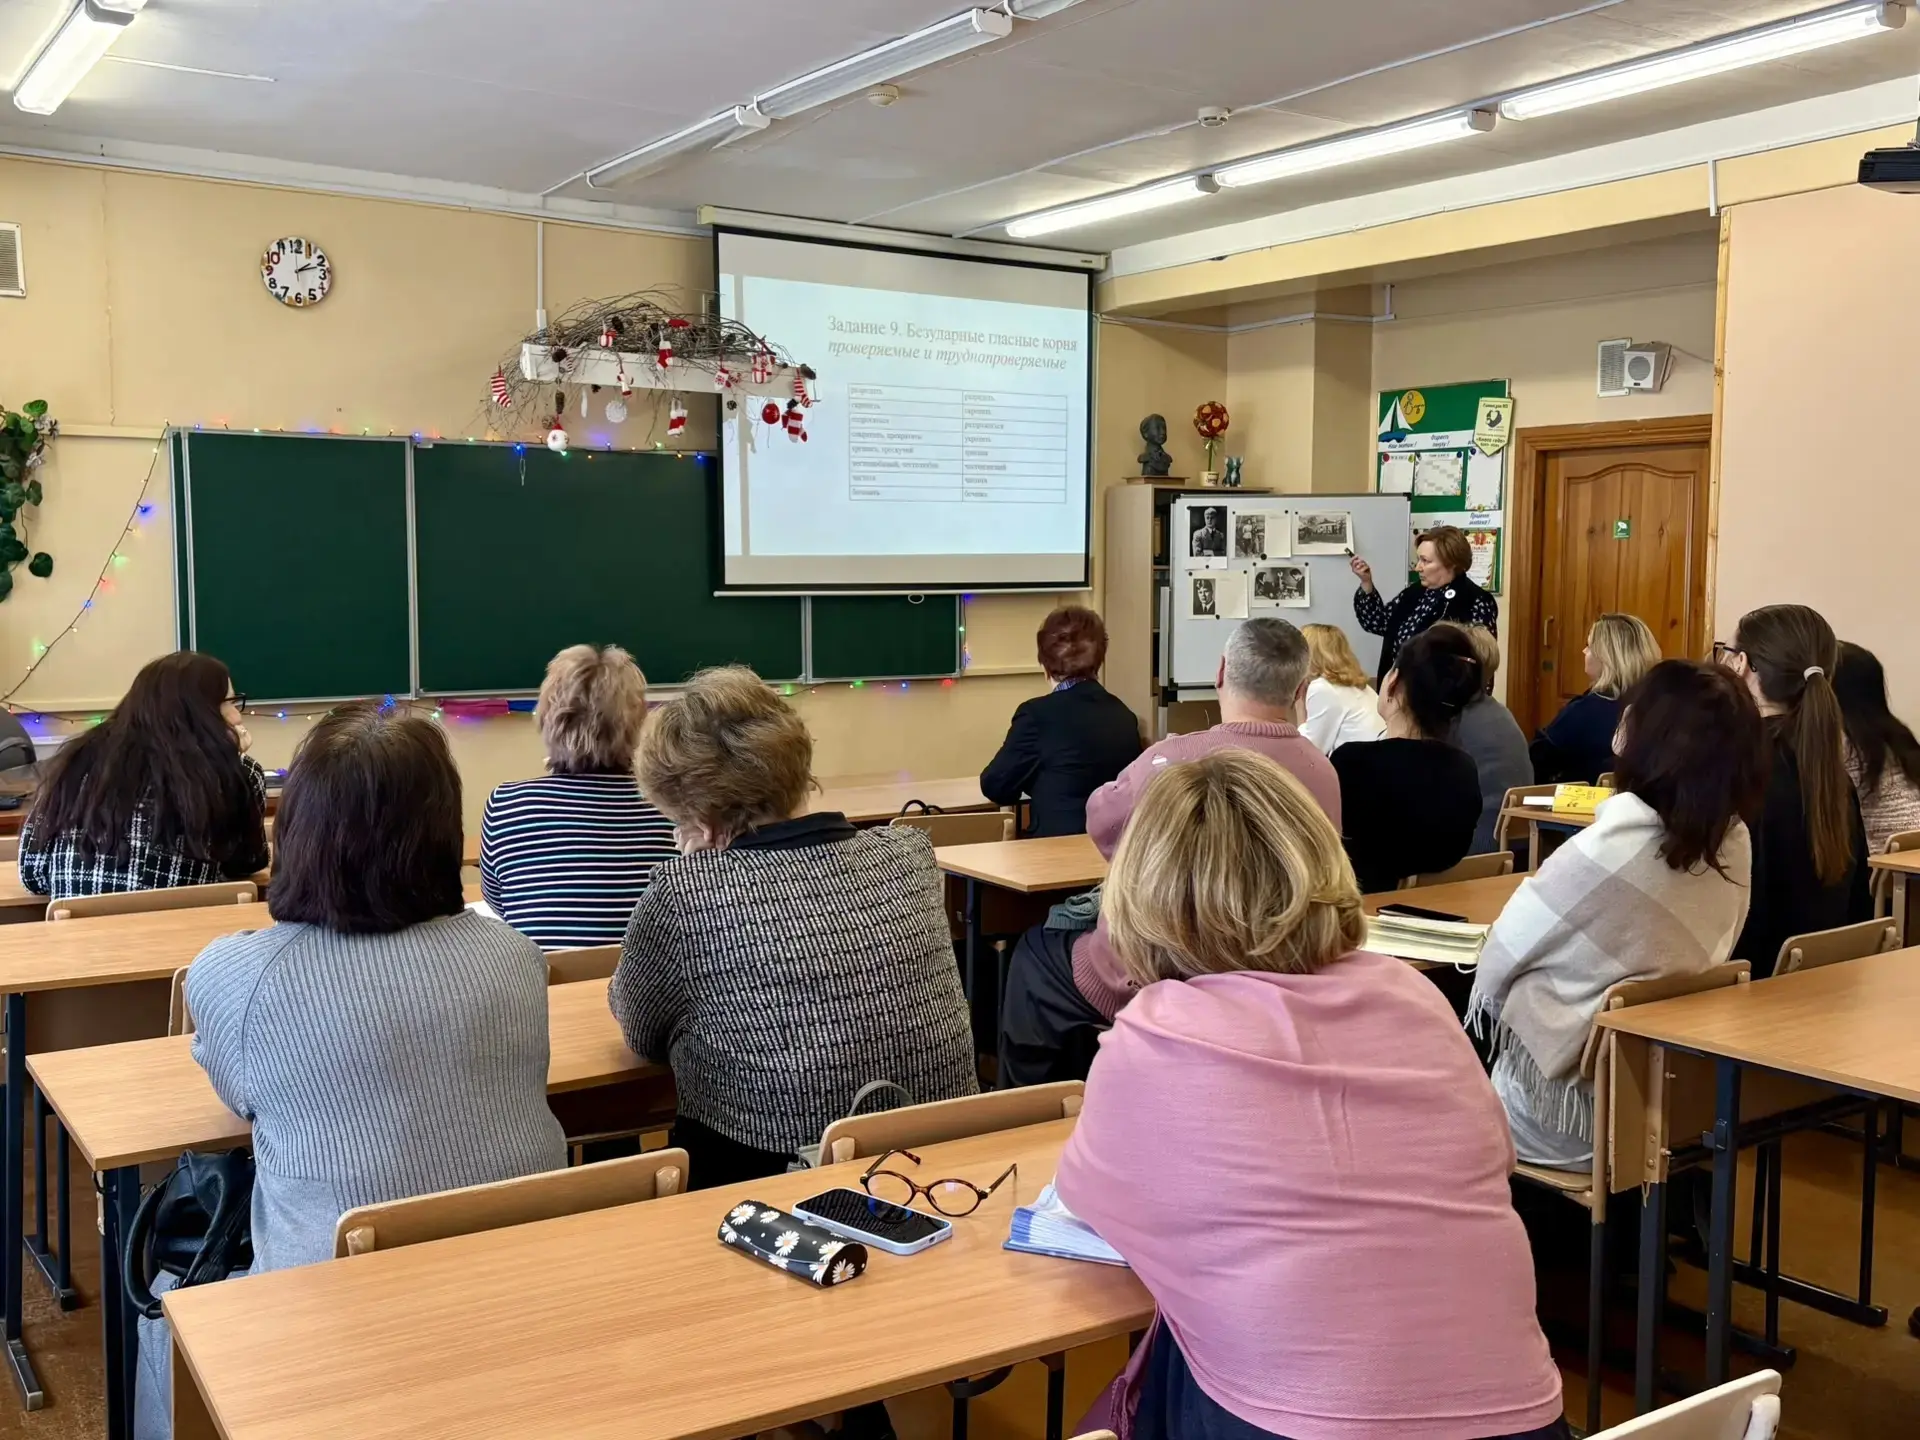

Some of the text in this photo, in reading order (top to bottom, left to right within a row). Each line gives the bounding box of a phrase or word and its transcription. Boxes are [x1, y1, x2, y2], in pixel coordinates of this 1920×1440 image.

[266, 251, 281, 265] 10
[316, 255, 326, 267] 2
[265, 265, 274, 276] 9
[318, 268, 327, 280] 3
[268, 277, 277, 289] 8
[280, 286, 290, 298] 7
[295, 292, 302, 304] 6
[308, 288, 317, 301] 5
[827, 314, 886, 335] Задание
[889, 321, 902, 336] 9.
[988, 332, 1040, 347] гласные
[1042, 336, 1078, 353] корня
[924, 349, 932, 360] и
